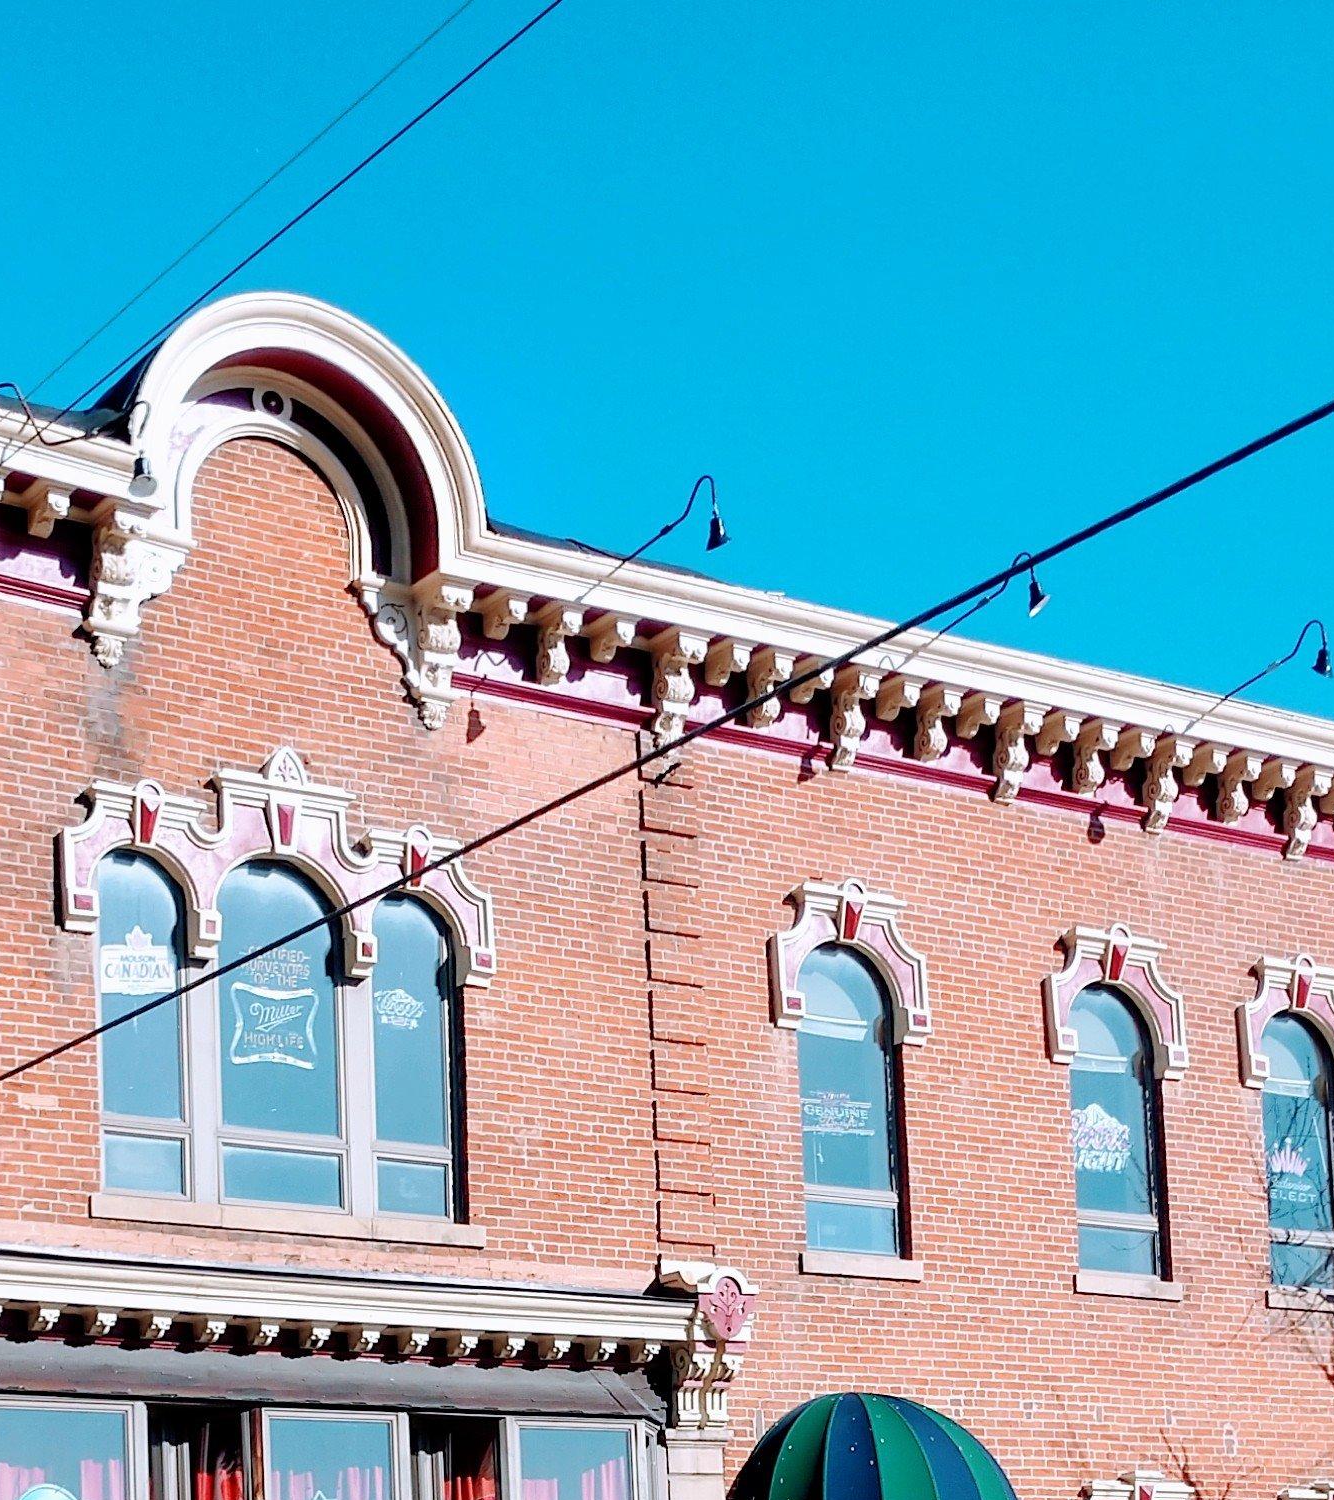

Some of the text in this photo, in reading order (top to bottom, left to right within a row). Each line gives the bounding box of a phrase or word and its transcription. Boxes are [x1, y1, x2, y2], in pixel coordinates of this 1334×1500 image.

[119, 955, 156, 963] MOLSON
[247, 946, 305, 963] CTIFIED
[104, 963, 171, 979] CANADIAN
[249, 1003, 303, 1025] Miller
[244, 1031, 277, 1046] HIGH
[803, 1105, 869, 1119] GENUINE
[1270, 1189, 1317, 1204] ELECT
